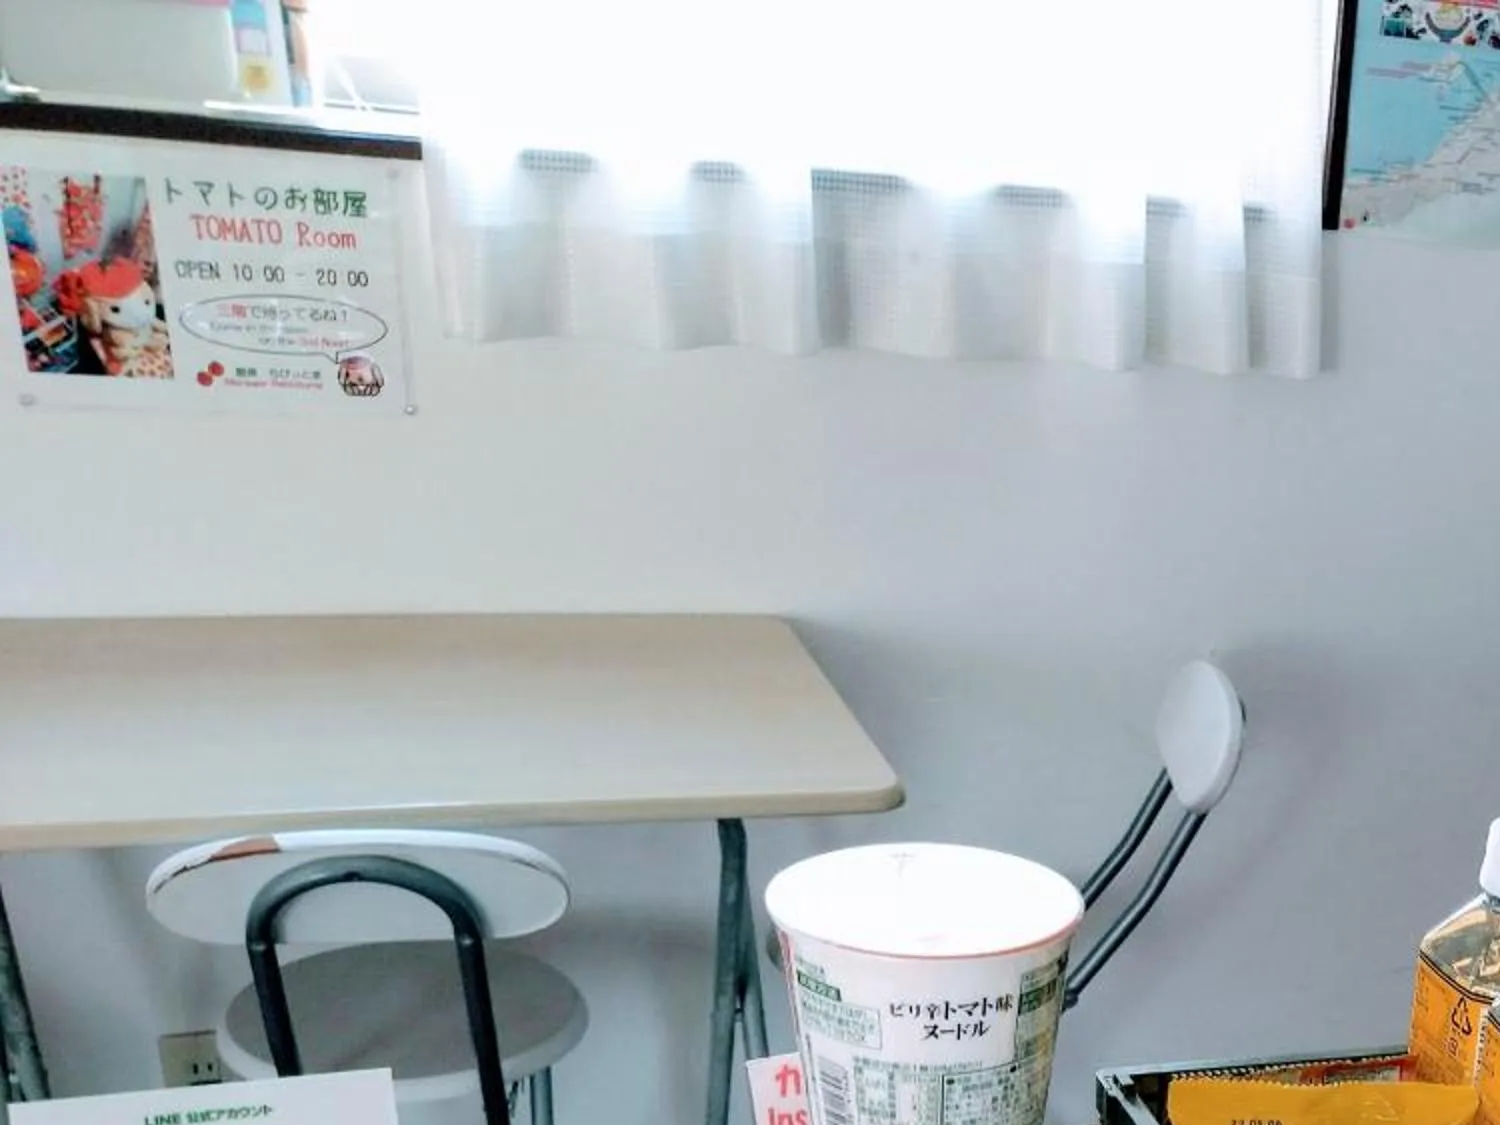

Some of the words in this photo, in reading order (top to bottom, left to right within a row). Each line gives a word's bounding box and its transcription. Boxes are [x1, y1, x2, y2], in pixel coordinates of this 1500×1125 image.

[165, 178, 368, 219] トマトのお部屋
[190, 214, 283, 246] TOMATO
[297, 222, 357, 249] Room
[175, 260, 221, 281] OPEN
[922, 1020, 991, 1041] ヌードル
[186, 1104, 273, 1124] 公式アカウント
